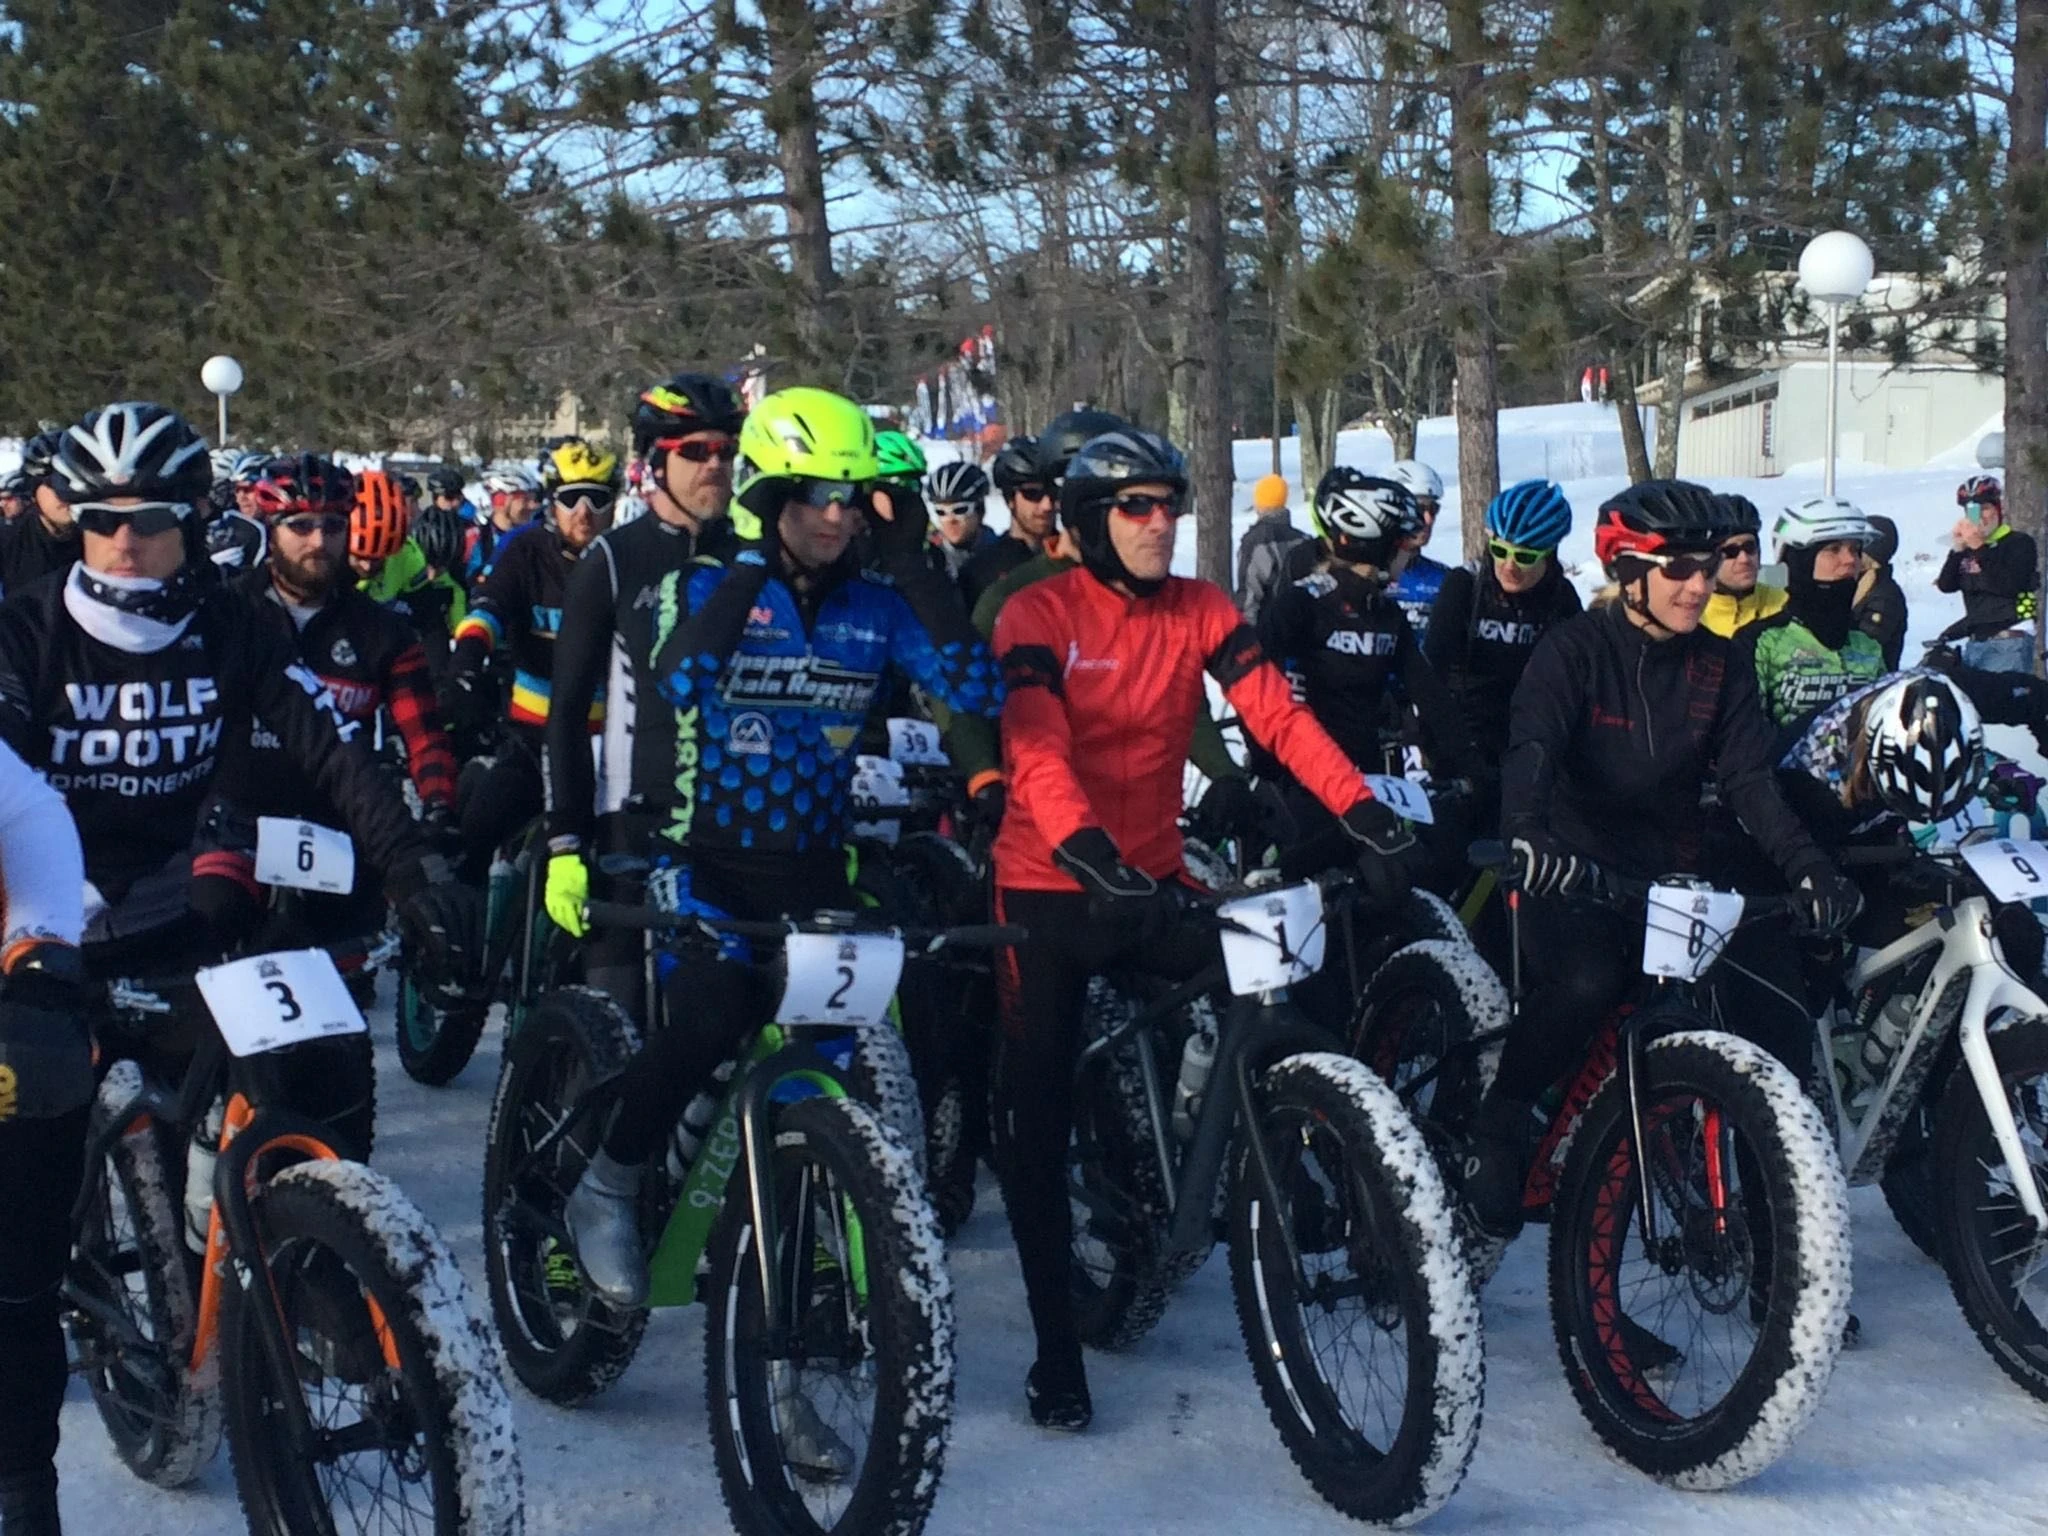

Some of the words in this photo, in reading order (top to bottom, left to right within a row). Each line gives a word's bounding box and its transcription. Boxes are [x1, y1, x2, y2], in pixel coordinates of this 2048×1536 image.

[64, 677, 218, 722] WOLF
[49, 716, 223, 768] TOOTH
[901, 731, 928, 754] 39
[50, 755, 215, 797] OMPONENTS
[1382, 782, 1411, 808] 11
[297, 840, 315, 872] 6
[2011, 856, 2041, 883] 9
[1273, 919, 1295, 965] 1
[1687, 918, 1706, 960] 8
[264, 981, 302, 1023] 3
[825, 965, 855, 1010] 2
